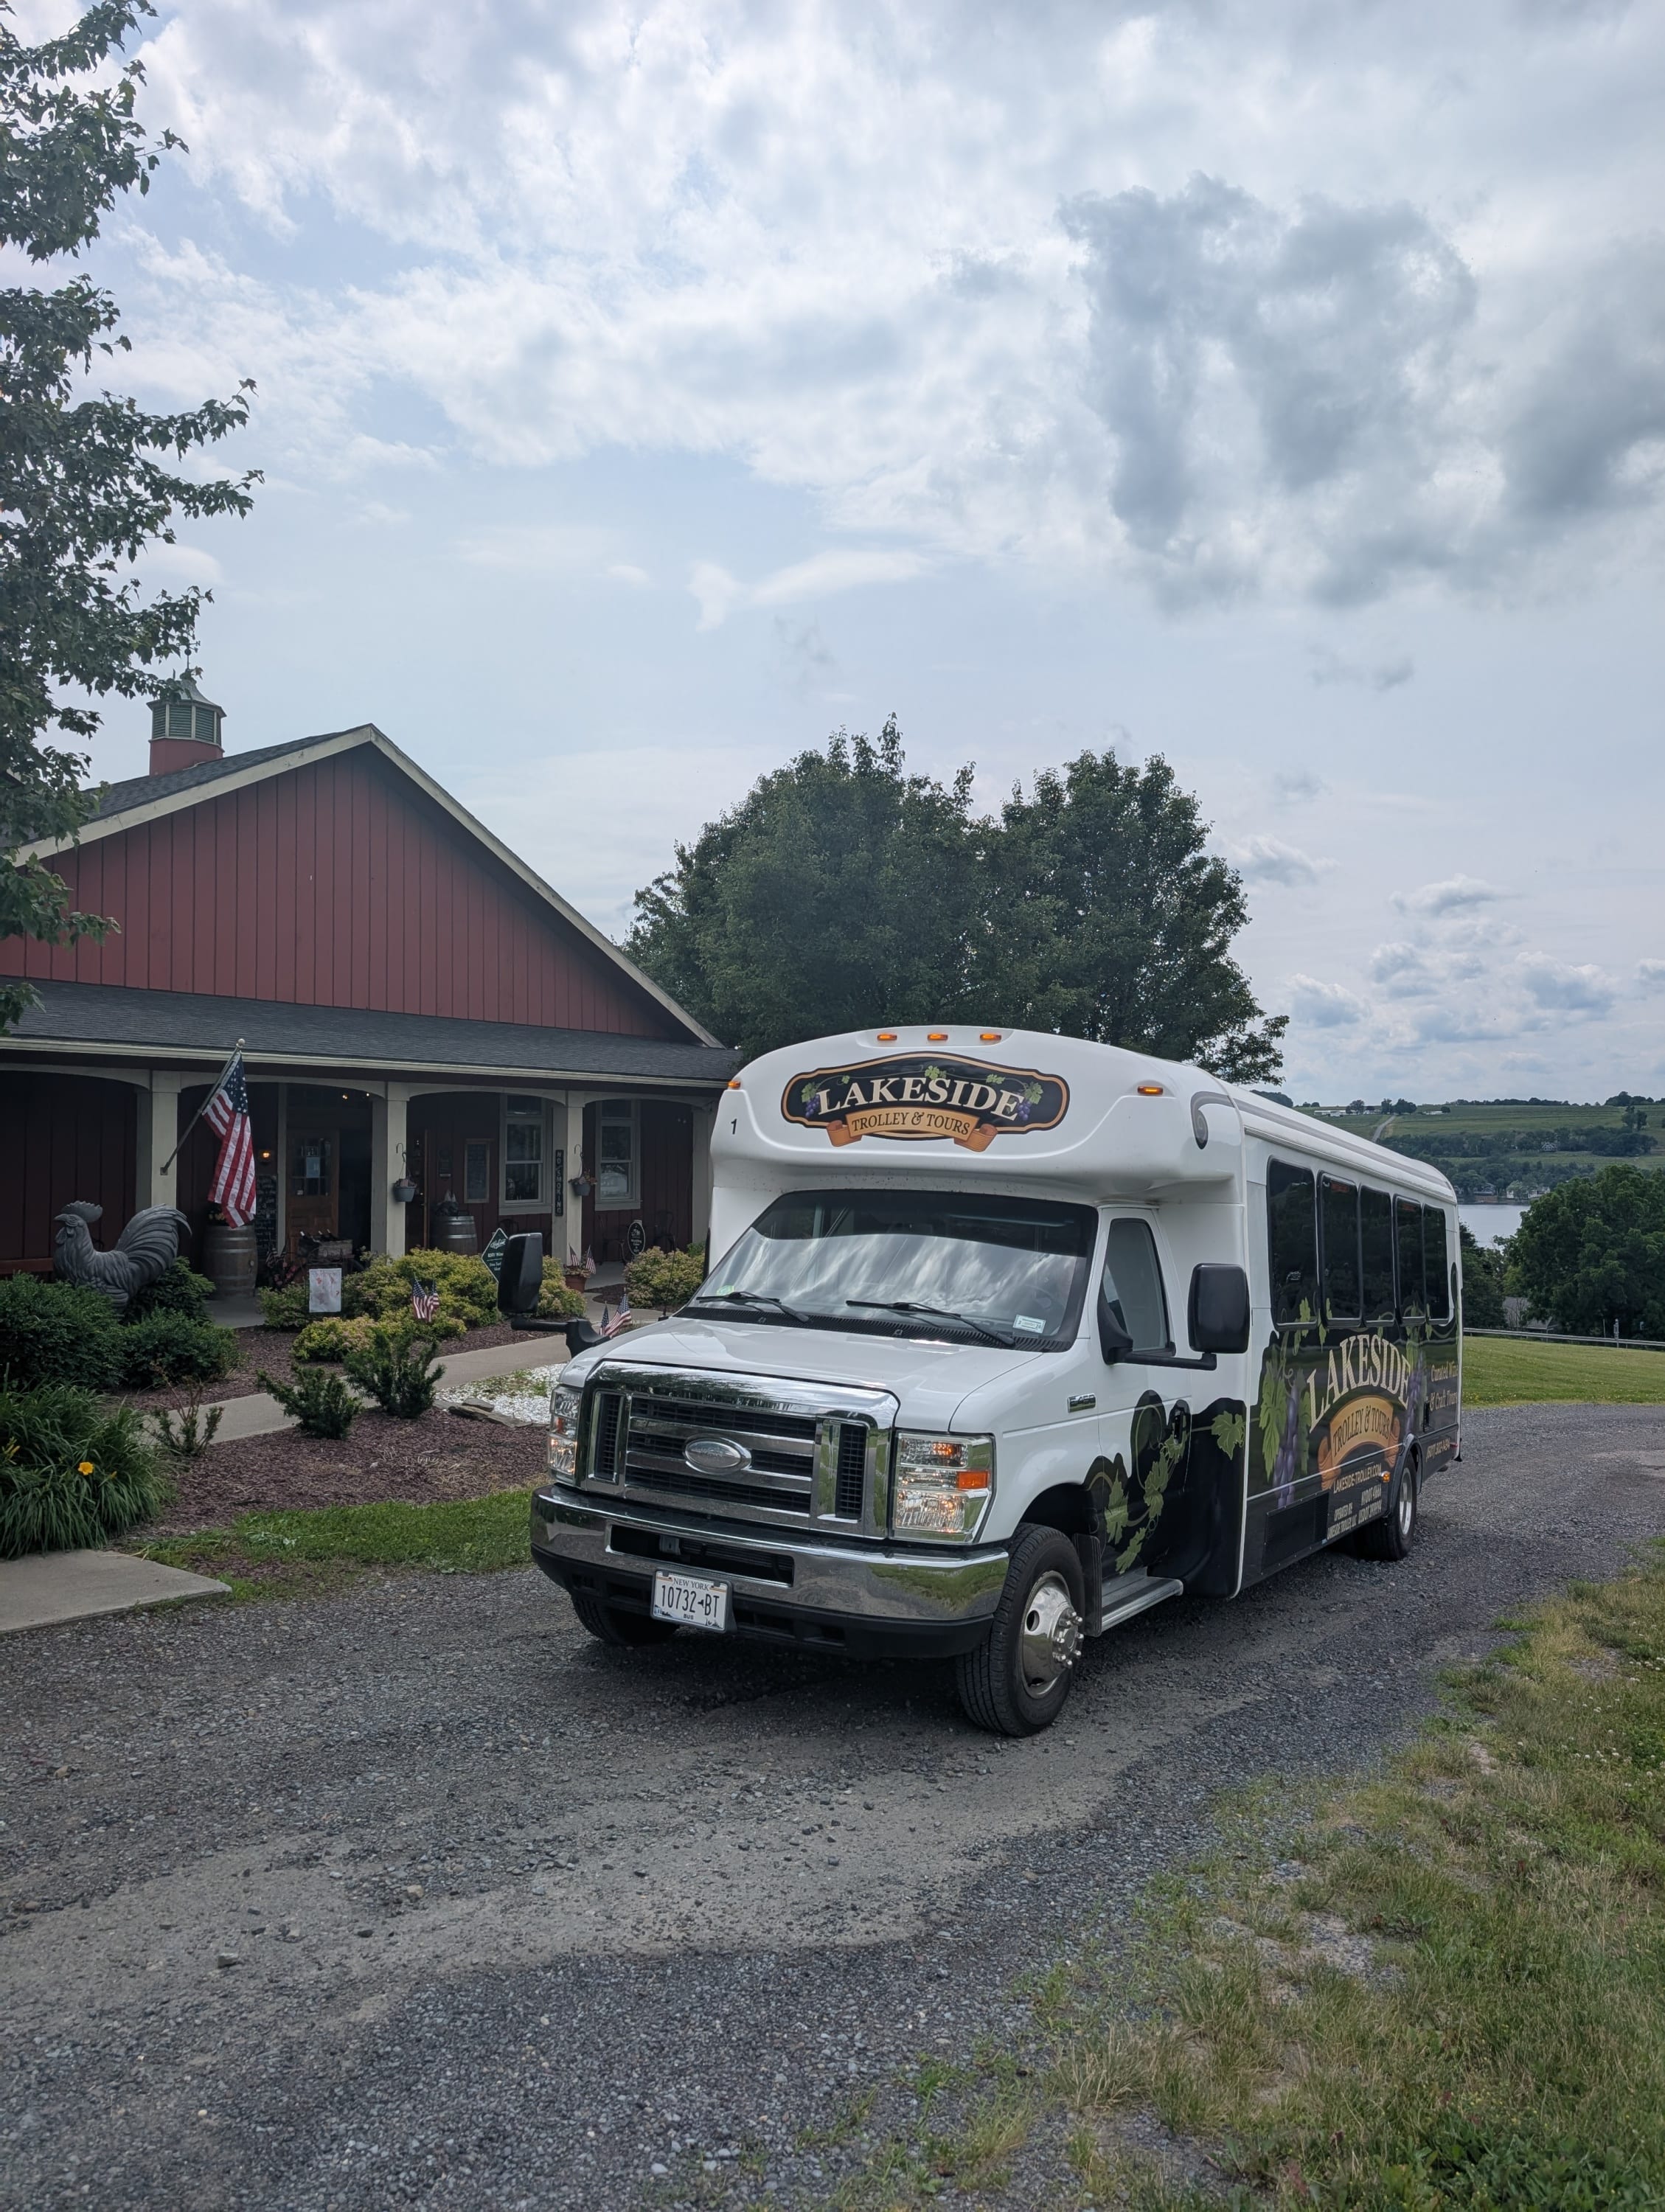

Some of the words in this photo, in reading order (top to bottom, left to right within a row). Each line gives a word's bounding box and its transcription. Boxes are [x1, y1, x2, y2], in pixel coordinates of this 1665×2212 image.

[816, 1076, 1024, 1121] LAKESIDE
[851, 1112, 907, 1132] TROLLEY
[911, 1111, 925, 1127] &
[927, 1113, 971, 1136] TOURS
[1307, 1334, 1411, 1434] LAKESIDE
[1332, 1408, 1364, 1457] TROLLEY
[1364, 1405, 1372, 1433] &
[1371, 1407, 1391, 1440] TOURS
[1333, 1462, 1382, 1494] LAKESIDE-TROLLEY.COM
[673, 1578, 690, 1587] NEW
[691, 1581, 709, 1591] YORK
